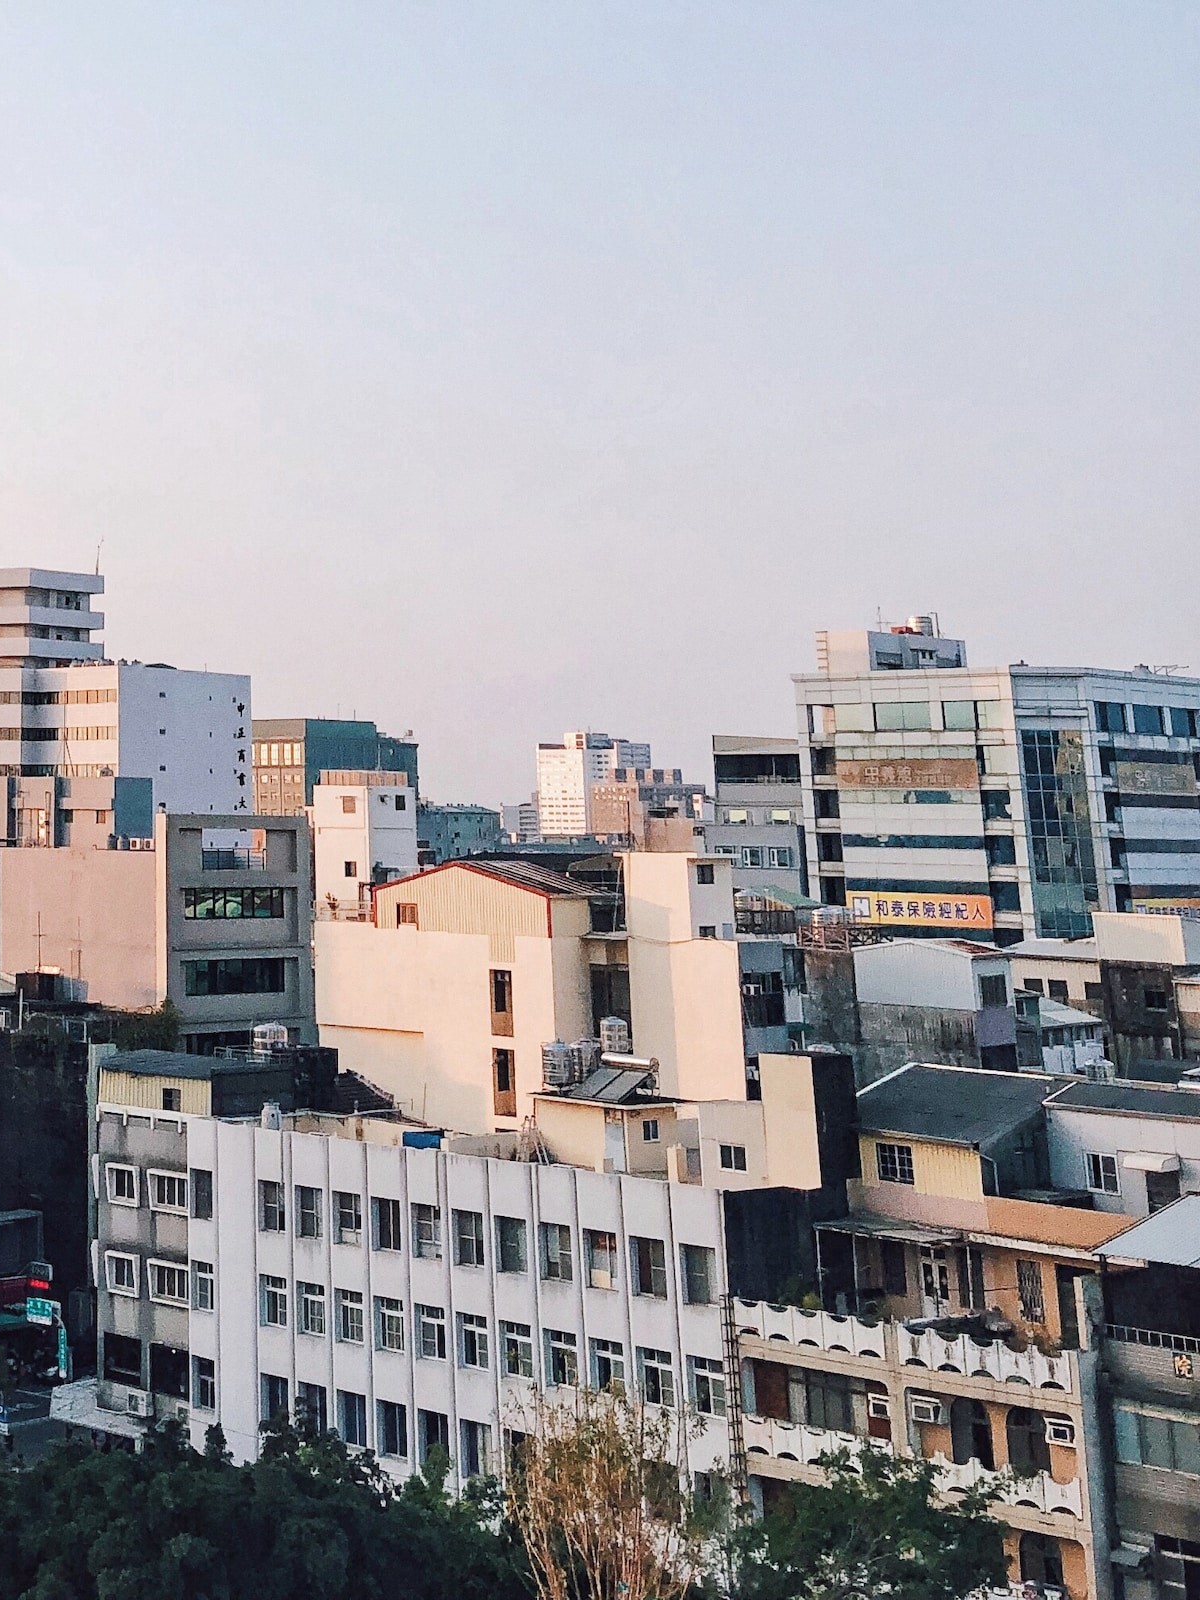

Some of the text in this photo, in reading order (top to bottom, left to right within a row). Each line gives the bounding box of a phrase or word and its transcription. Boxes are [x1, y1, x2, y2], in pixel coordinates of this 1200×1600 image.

[237, 702, 247, 832] 中正商業大
[875, 899, 985, 920] 和泰保險經紀人
[1174, 1354, 1193, 1378] 院
